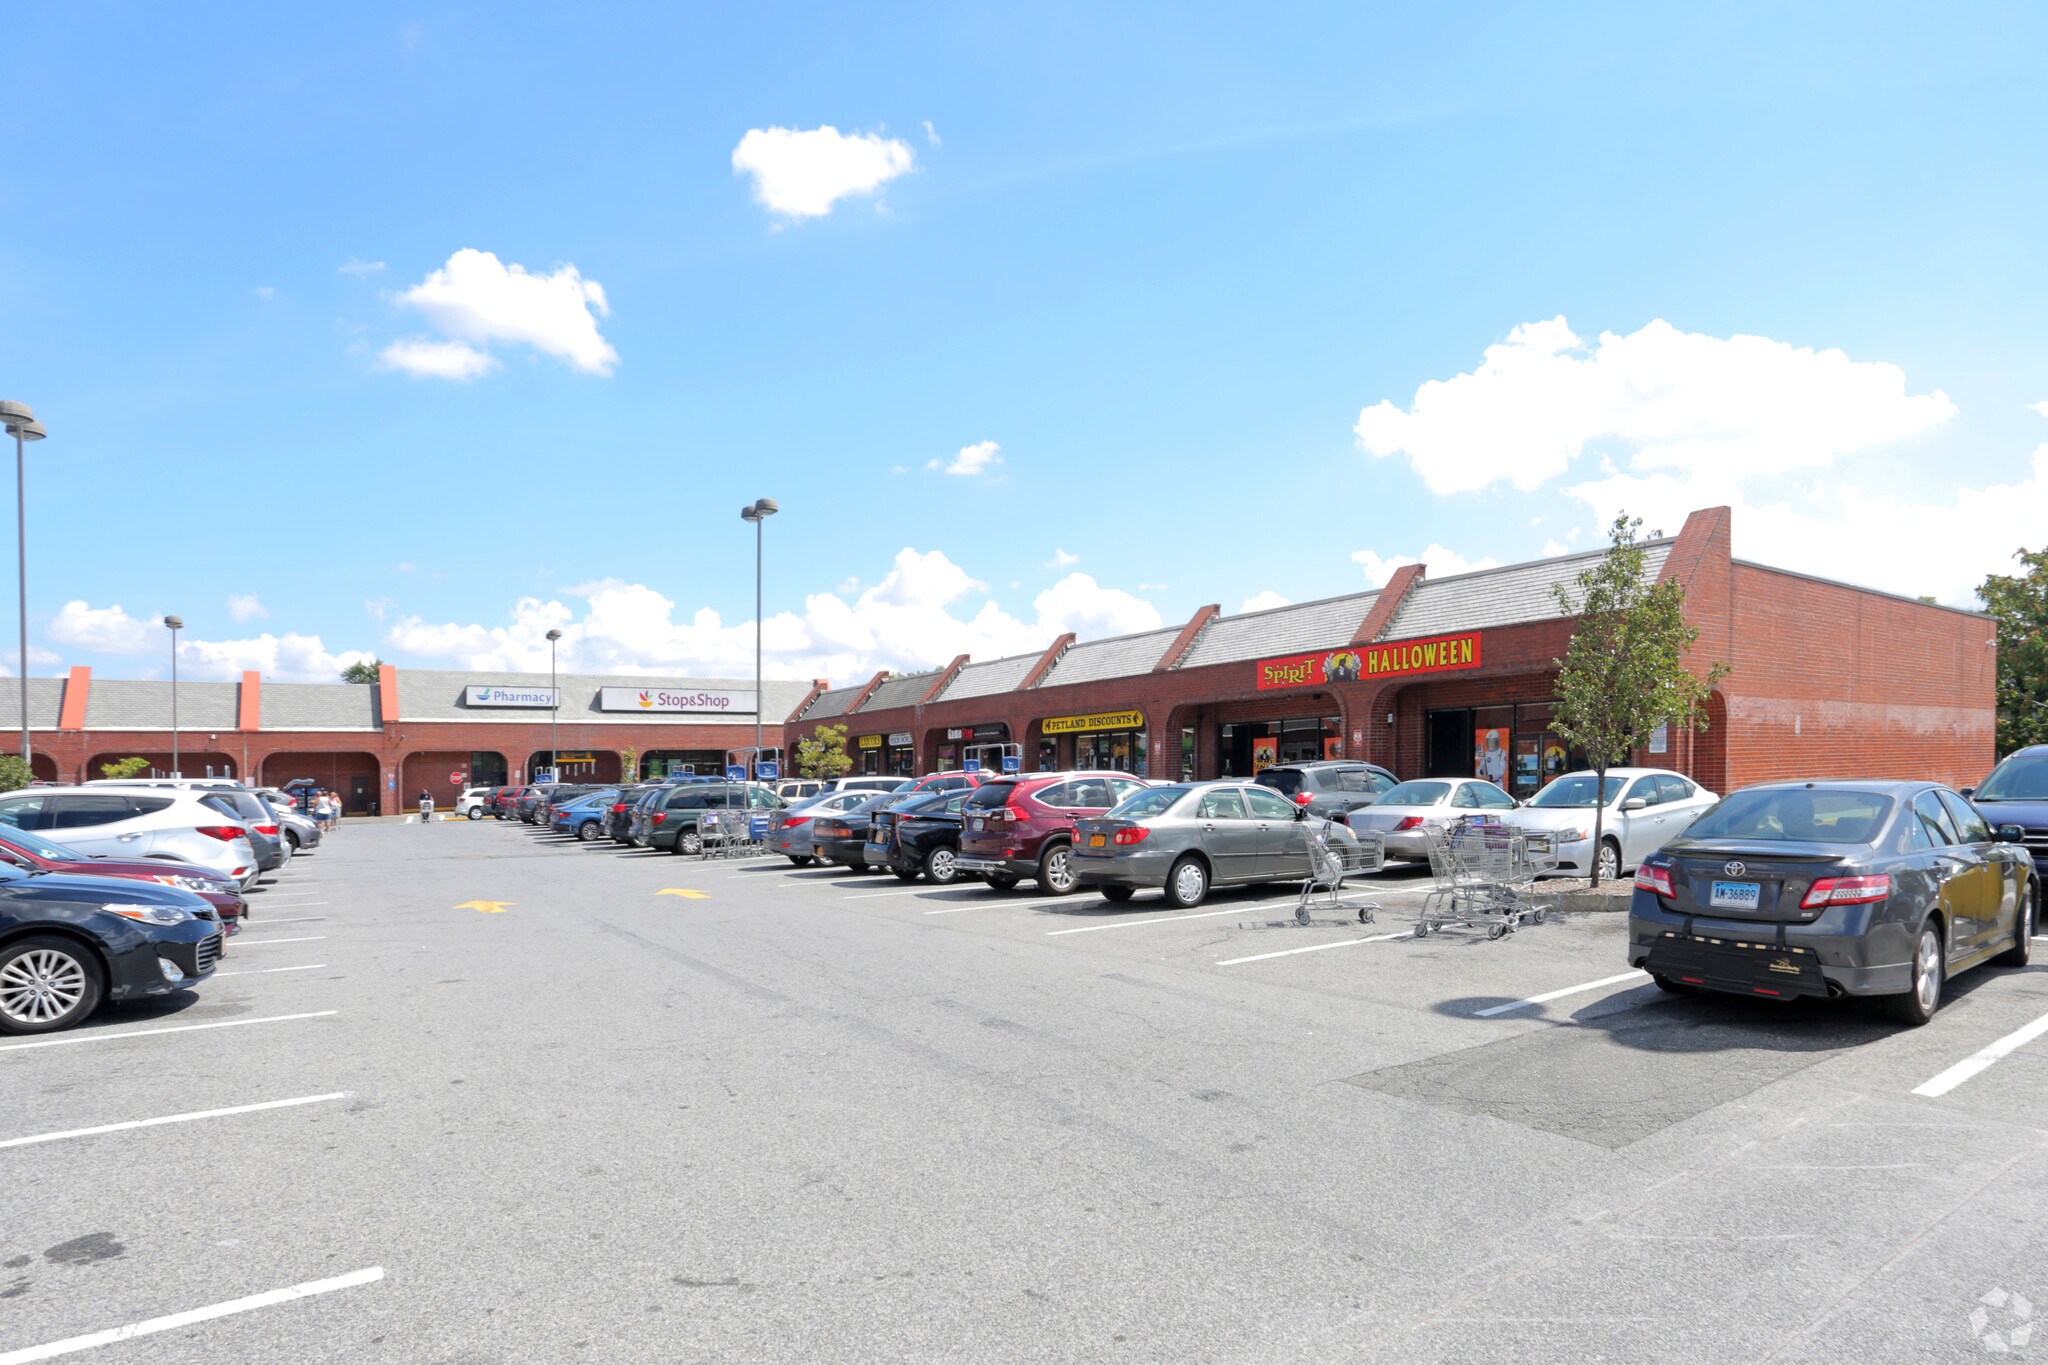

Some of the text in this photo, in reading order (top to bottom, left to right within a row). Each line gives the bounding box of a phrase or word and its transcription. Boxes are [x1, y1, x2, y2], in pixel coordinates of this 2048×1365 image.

[1264, 638, 1473, 685] SPIRIT HALLOWEEN
[494, 690, 552, 704] Pharmacy
[658, 692, 730, 709] Stop&Shop
[1052, 714, 1132, 730] PETLAND DISCOUNTS
